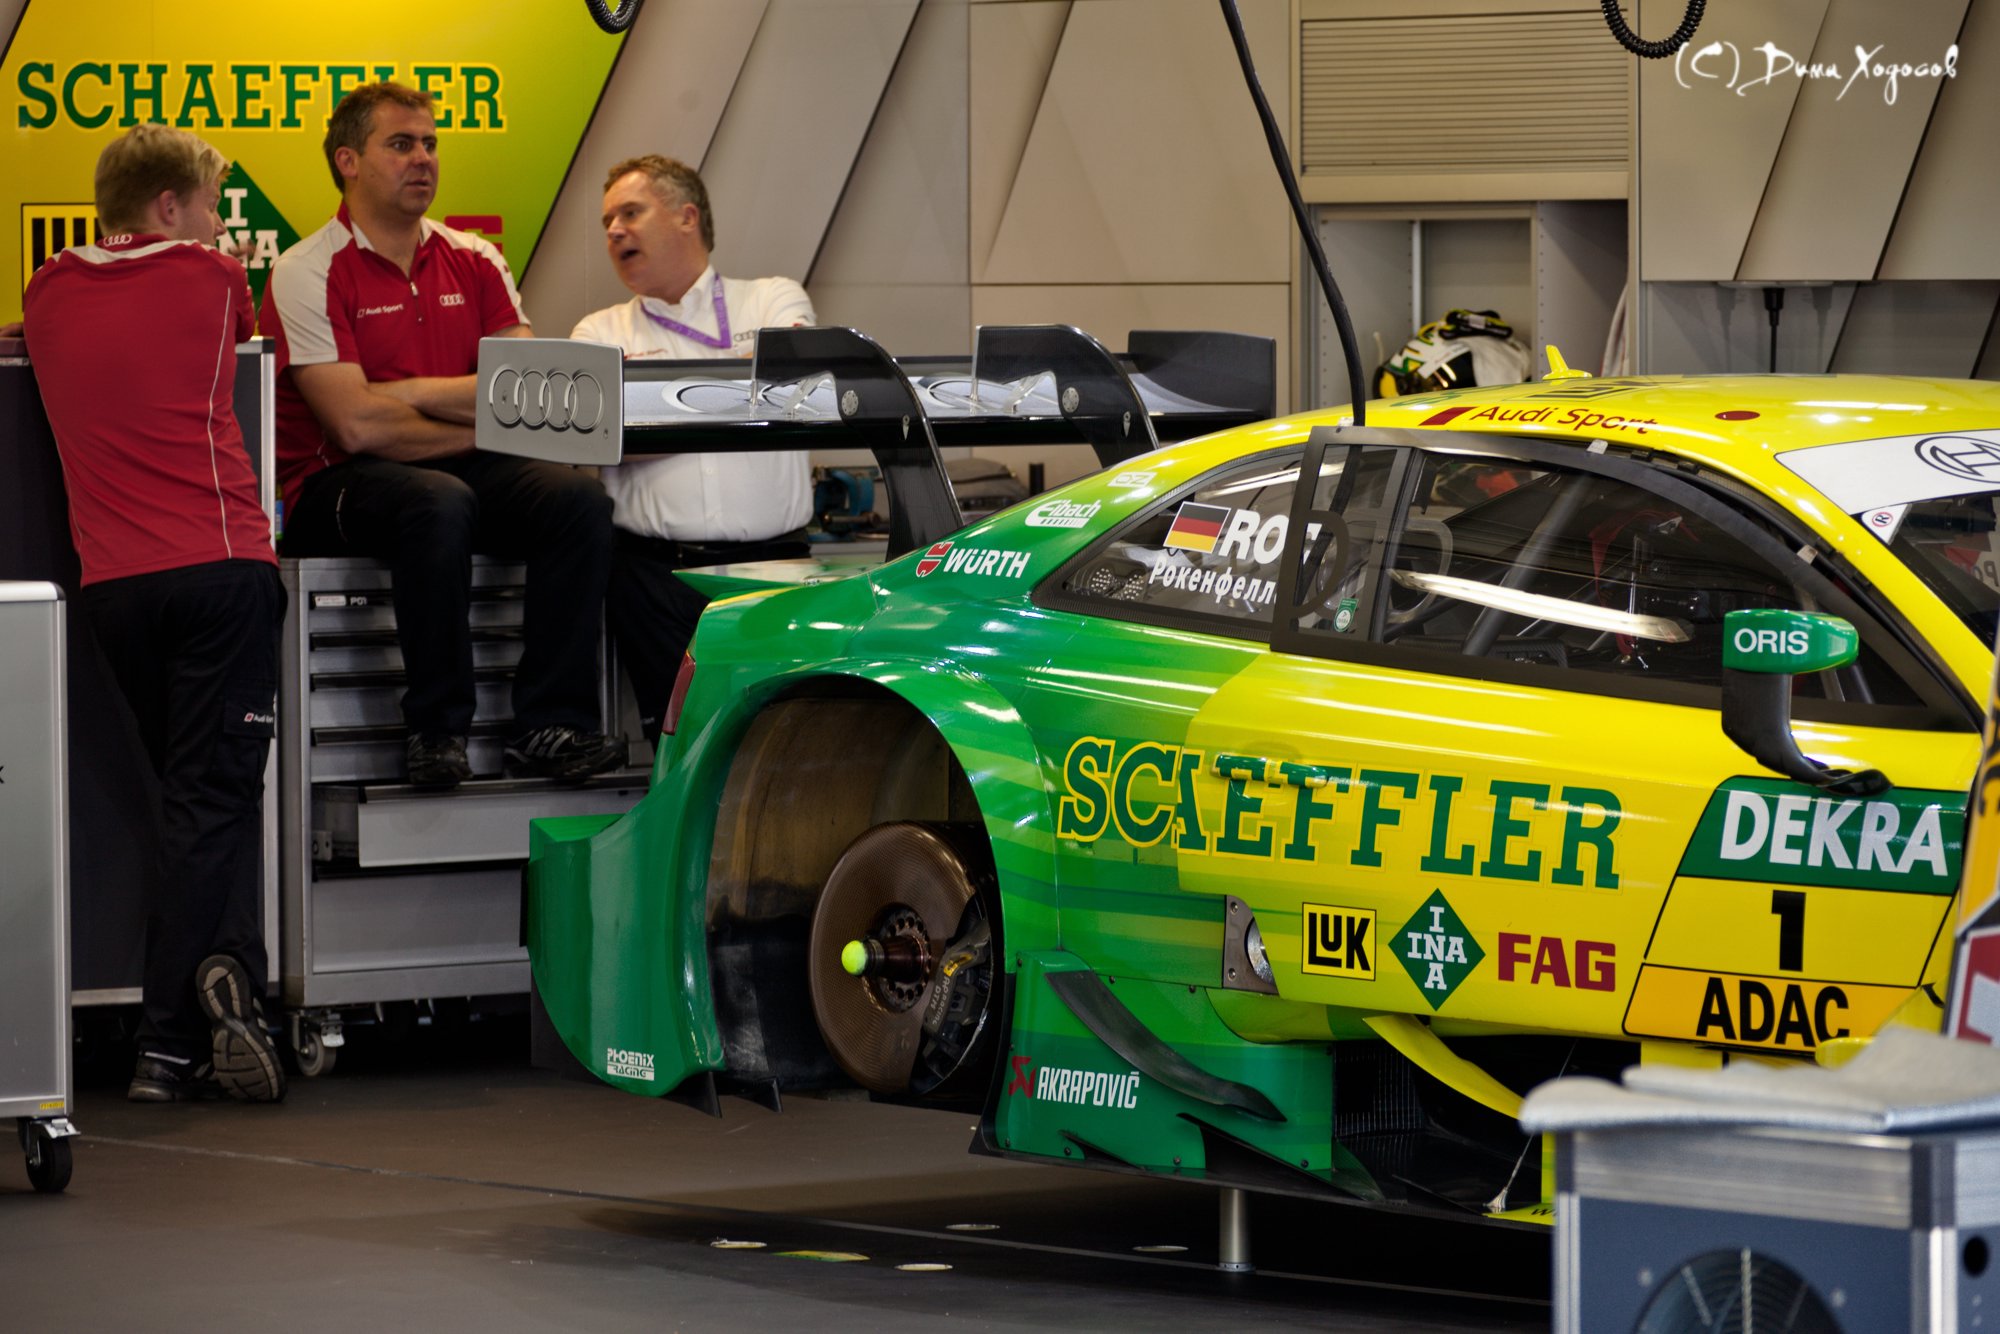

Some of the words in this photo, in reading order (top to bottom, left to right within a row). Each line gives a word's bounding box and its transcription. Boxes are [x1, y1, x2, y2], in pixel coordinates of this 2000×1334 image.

[1468, 406, 1552, 422] Audi
[1557, 408, 1659, 435] Sport
[1025, 499, 1102, 528] Eibach
[943, 547, 1032, 579] WÜRTH
[1148, 555, 1277, 604] Рокенфелл
[1734, 628, 1809, 655] ORIS
[1720, 790, 1949, 876] DEKRA
[1771, 889, 1806, 972] 1
[1498, 932, 1616, 992] FAG
[1696, 976, 1850, 1048] ADAC
